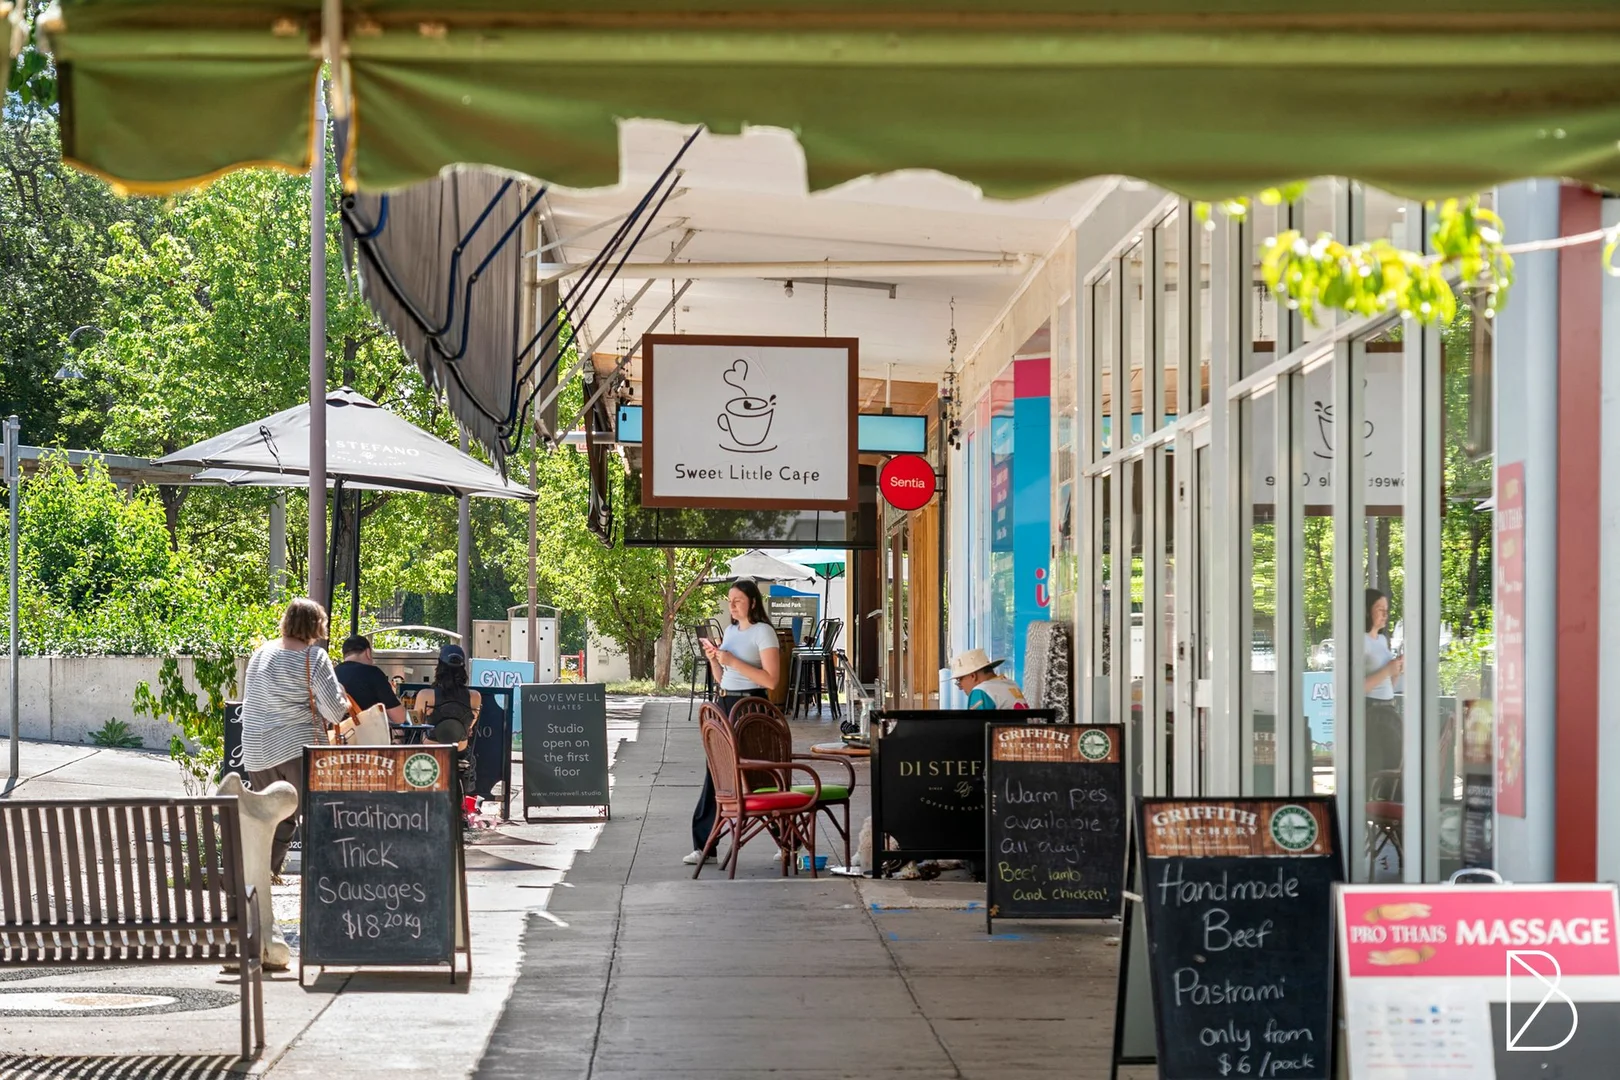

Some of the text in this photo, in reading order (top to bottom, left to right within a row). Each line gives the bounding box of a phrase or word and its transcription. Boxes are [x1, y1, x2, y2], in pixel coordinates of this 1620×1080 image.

[336, 440, 420, 457] STEFANO
[674, 463, 820, 485] Sweet Little Cafe
[889, 476, 926, 489] Sentia
[480, 670, 523, 688] GNCA
[528, 693, 601, 703] MOVEWELL
[547, 723, 584, 734] Studio
[999, 728, 1071, 744] GRIFFITH
[542, 740, 590, 751] open on
[1000, 742, 1071, 750] BUTCHERY
[315, 754, 395, 769] GRIFFITH
[543, 752, 590, 762] the first
[317, 769, 394, 777] BUTCHERY
[553, 766, 581, 777] floor
[900, 760, 982, 777] DI STEF
[1005, 777, 1108, 811] Warm pies
[323, 800, 430, 832] Traditional
[1152, 806, 1258, 827] GRIFFITH
[1156, 826, 1259, 837] BUTCHERY
[333, 836, 400, 869] Thick
[1048, 866, 1082, 882] lamb
[1157, 862, 1300, 907] Handmade
[318, 876, 426, 911] Sausages
[1013, 887, 1048, 901] and
[1202, 908, 1274, 952] Beef
[1350, 917, 1611, 946] PRO THAIS MASSAGE
[1173, 967, 1286, 1006] Pastrami
[1199, 1018, 1314, 1052] only from
